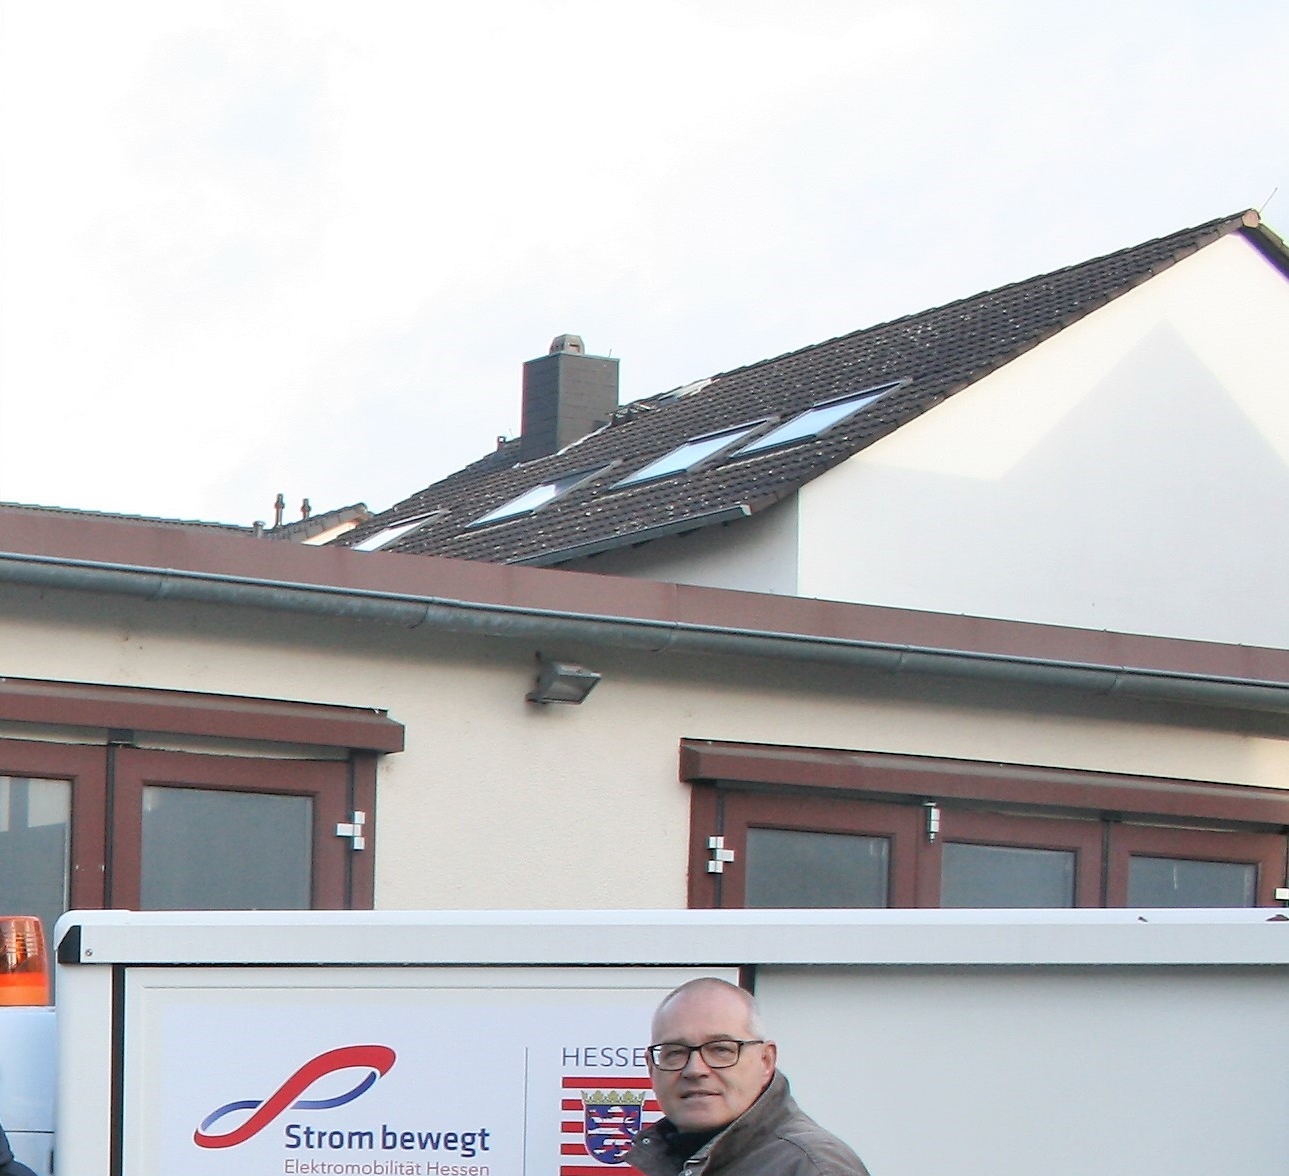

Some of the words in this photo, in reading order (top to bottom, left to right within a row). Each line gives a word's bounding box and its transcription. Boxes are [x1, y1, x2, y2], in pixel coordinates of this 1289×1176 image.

[563, 1047, 647, 1067] HESSE
[285, 1125, 374, 1150] Strom
[382, 1125, 490, 1158] bewegt
[284, 1159, 421, 1176] Elektromobilität
[427, 1162, 490, 1176] Hessen
